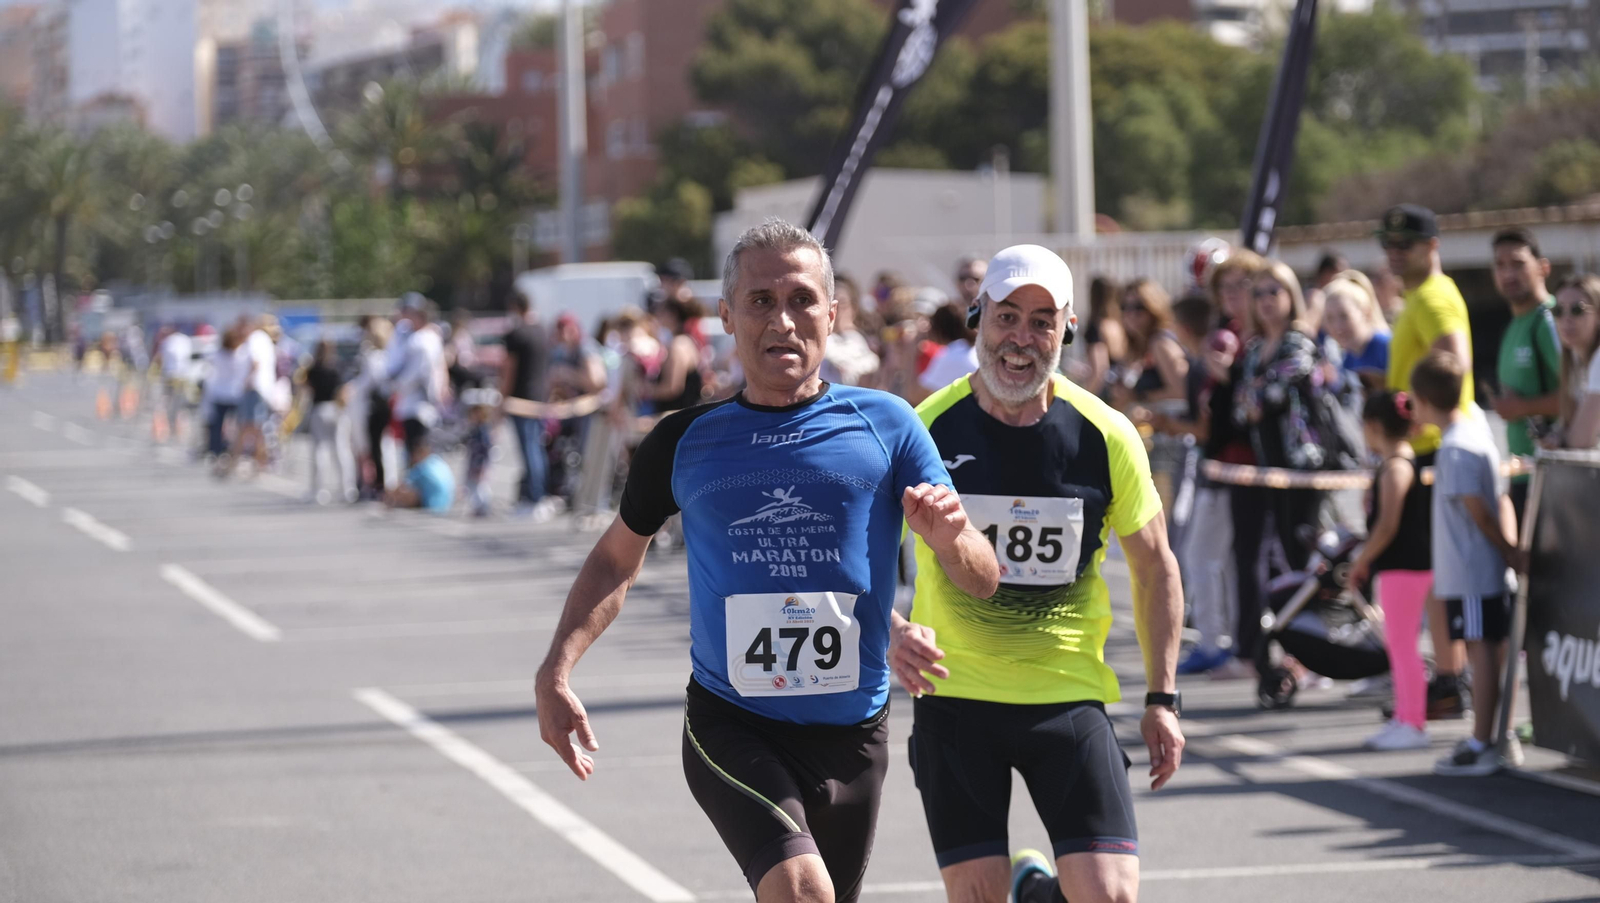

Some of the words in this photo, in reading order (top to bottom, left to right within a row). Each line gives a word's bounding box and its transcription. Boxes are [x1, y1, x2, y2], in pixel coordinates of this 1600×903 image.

[728, 527, 765, 536] COSTA
[768, 526, 781, 535] DE
[757, 536, 810, 548] ULTRA
[981, 524, 1063, 564] 185
[731, 548, 841, 564] MARATON
[768, 564, 808, 577] 2019
[745, 626, 842, 672] 479
